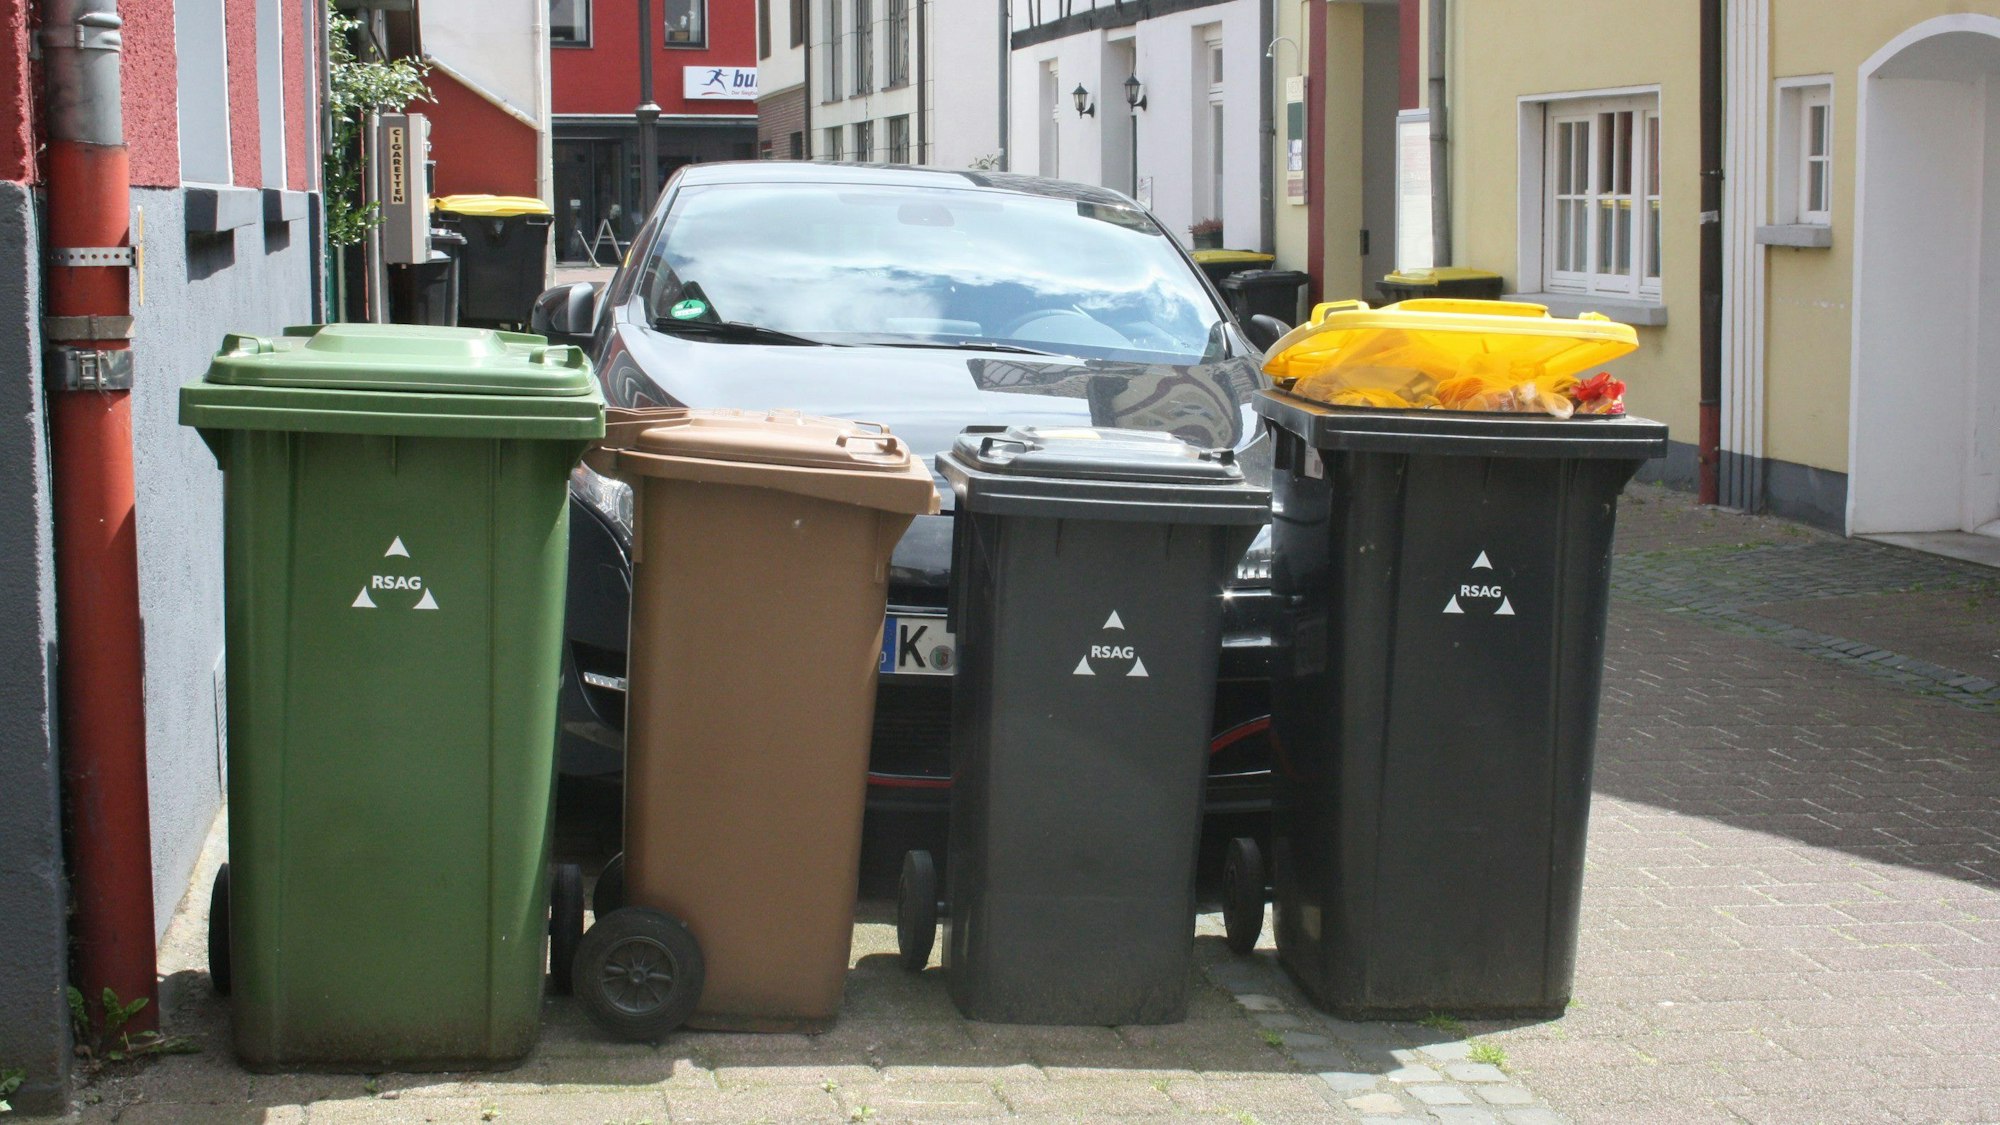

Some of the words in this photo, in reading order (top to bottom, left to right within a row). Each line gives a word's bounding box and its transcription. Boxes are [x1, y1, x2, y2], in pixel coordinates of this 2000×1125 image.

[392, 129, 403, 202] CIGARETTEN
[683, 300, 693, 309] 4
[372, 575, 422, 590] RSAG
[1461, 584, 1502, 598] RSAG
[898, 624, 928, 668] K
[1091, 645, 1134, 659] RSAG
